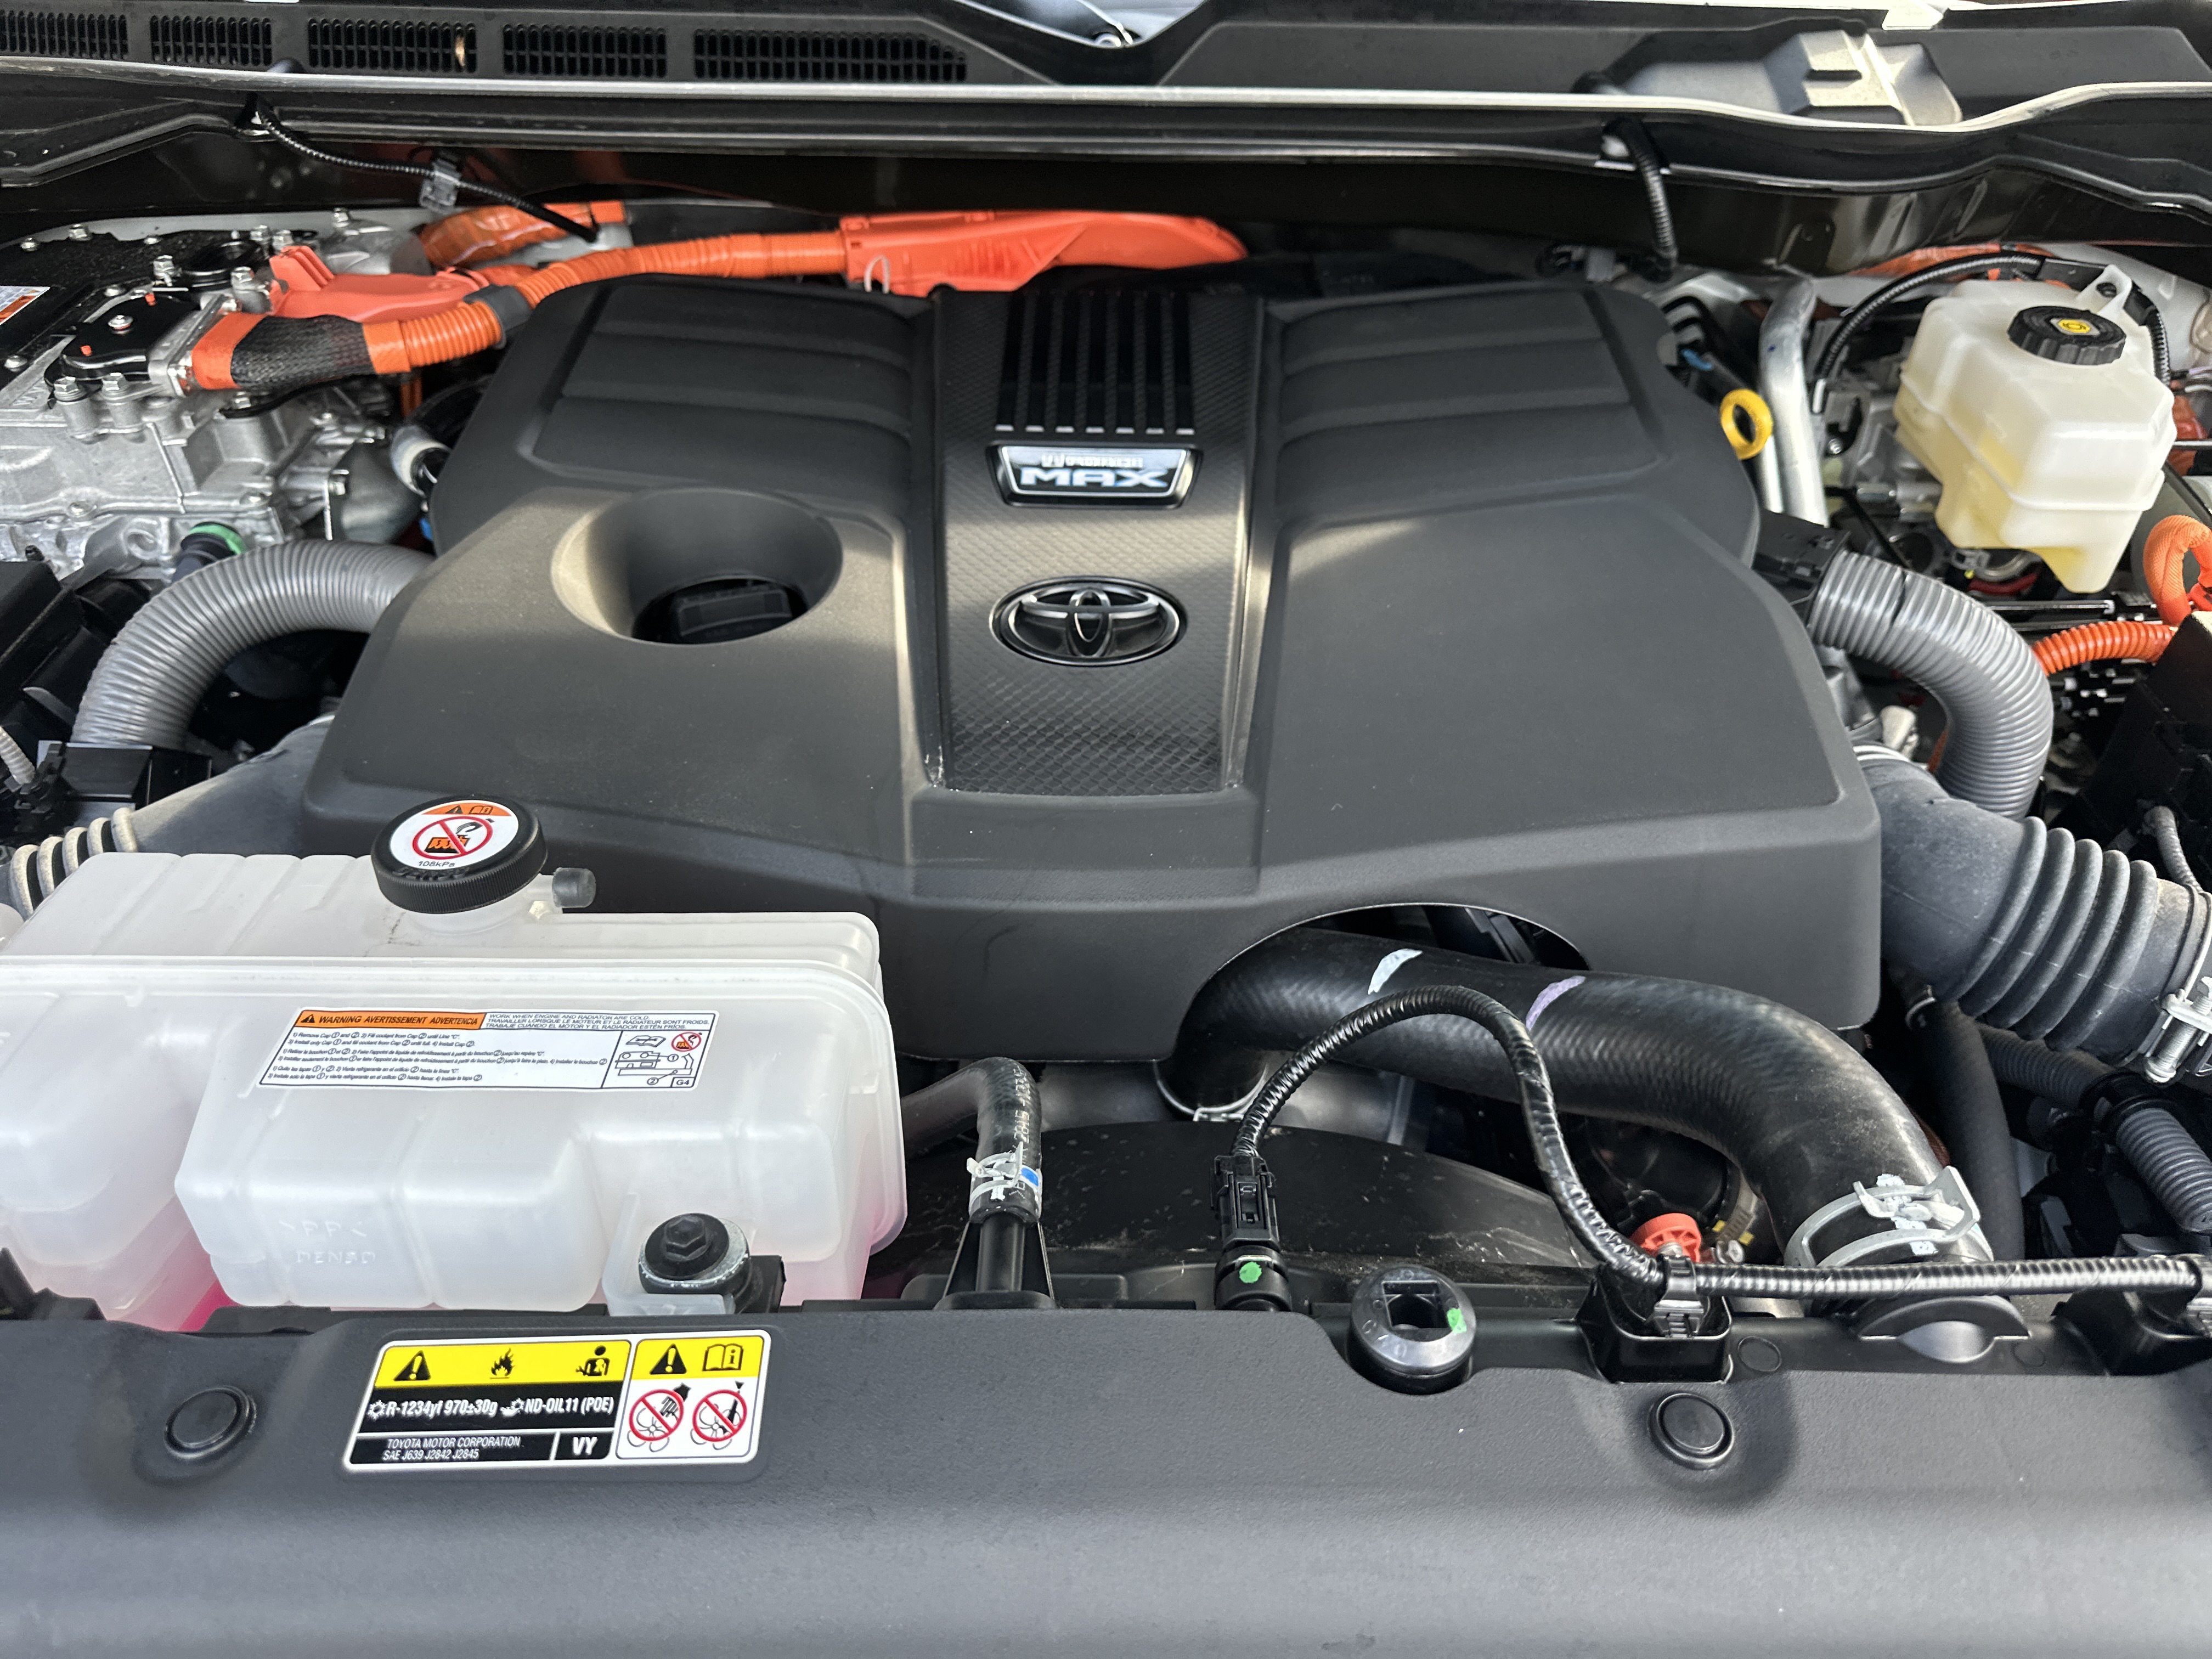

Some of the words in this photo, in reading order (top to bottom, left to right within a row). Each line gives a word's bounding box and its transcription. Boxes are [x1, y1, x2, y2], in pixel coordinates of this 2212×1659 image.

[1020, 467, 1168, 488] MAX
[363, 1015, 428, 1024] AVERTISSEMENT
[429, 1017, 478, 1025] ADVERTENCIA
[297, 1251, 376, 1263] DENSO
[386, 1399, 443, 1419] R-1234yf
[444, 1398, 498, 1418] 970±30g
[524, 1397, 580, 1414] ND-OIL11
[580, 1396, 615, 1415] (POE)
[387, 1438, 421, 1449] TOYOTA
[422, 1437, 456, 1449] MOTOR
[456, 1435, 521, 1448] CORPORATION
[572, 1436, 598, 1457] VY
[382, 1450, 402, 1461] SAE
[402, 1449, 424, 1460] J639
[424, 1449, 452, 1460] J2842
[452, 1448, 480, 1460] J2845
